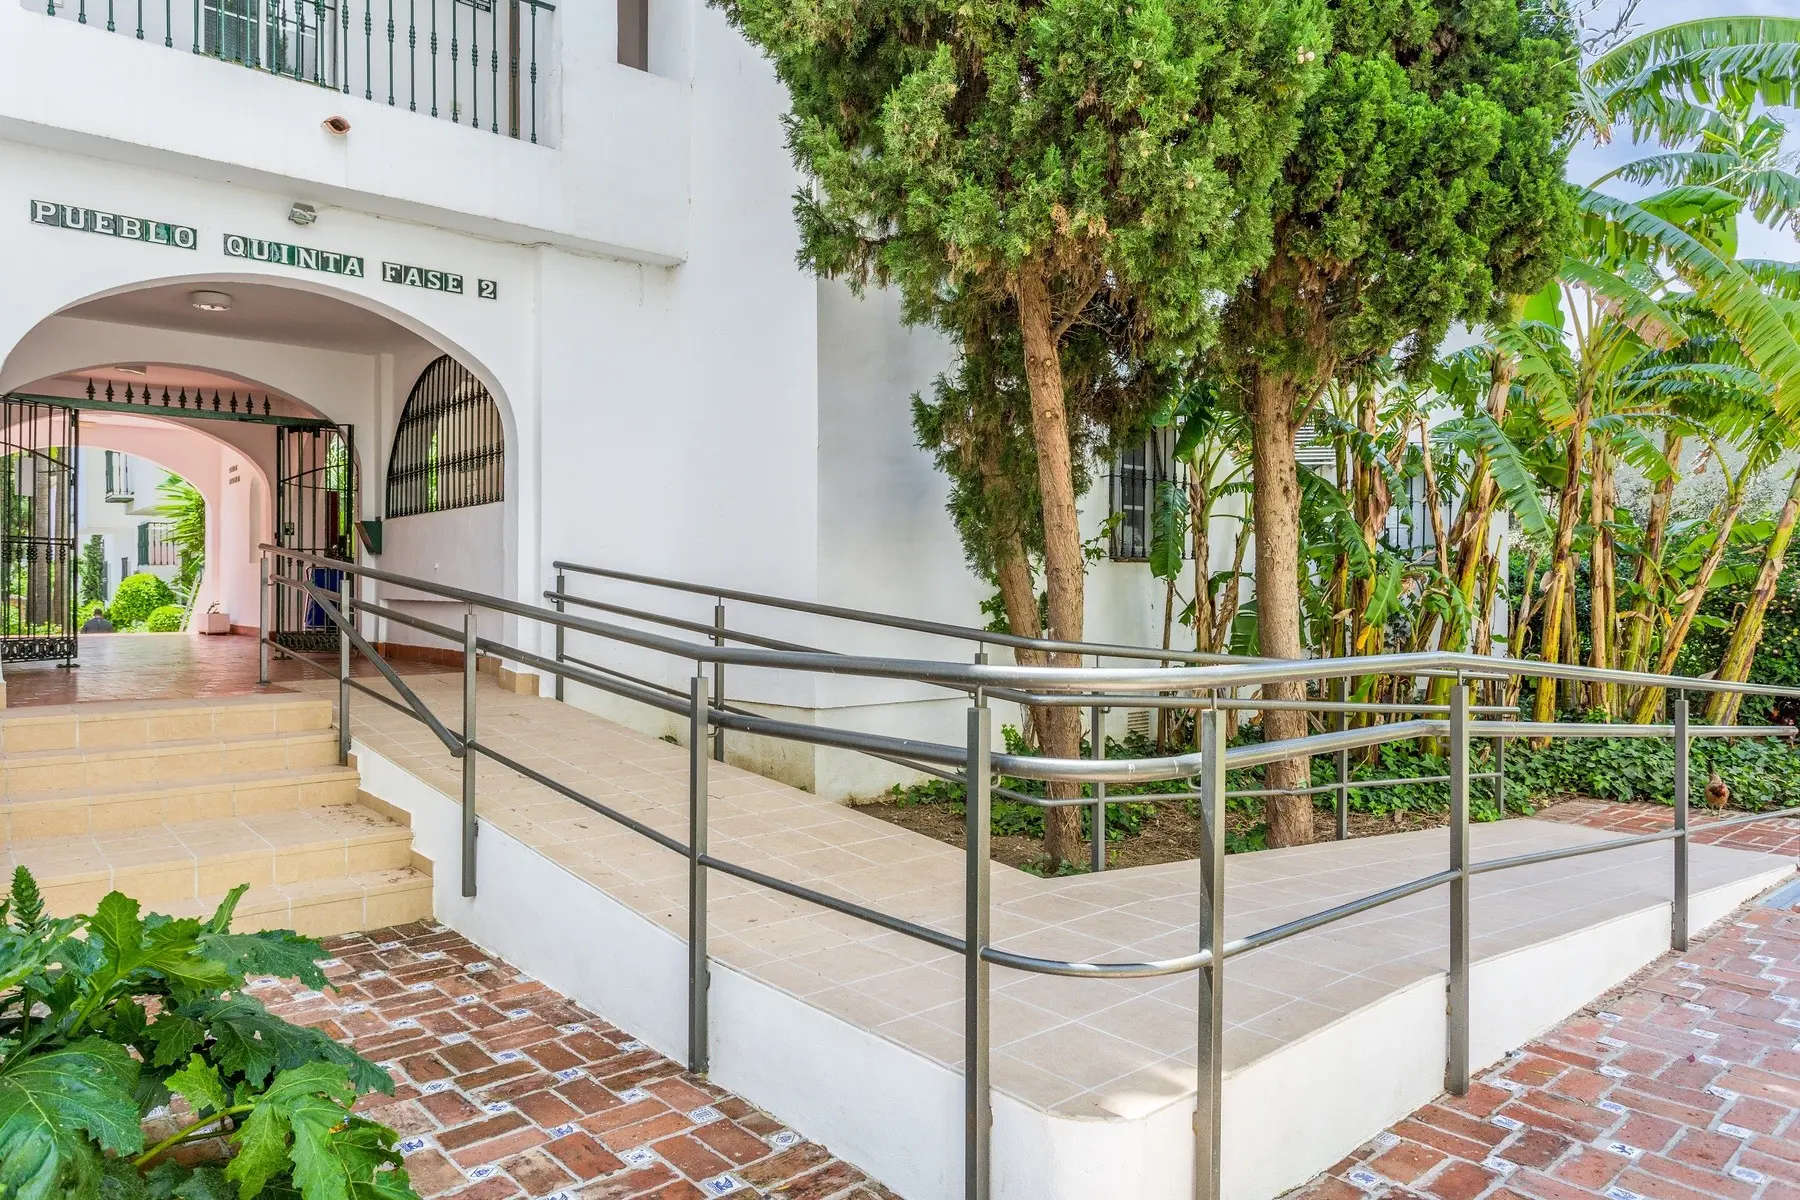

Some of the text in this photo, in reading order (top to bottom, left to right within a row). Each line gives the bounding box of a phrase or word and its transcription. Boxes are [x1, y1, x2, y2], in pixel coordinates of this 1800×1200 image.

[33, 200, 495, 298] PUEBLO QUINTA FASE 2
